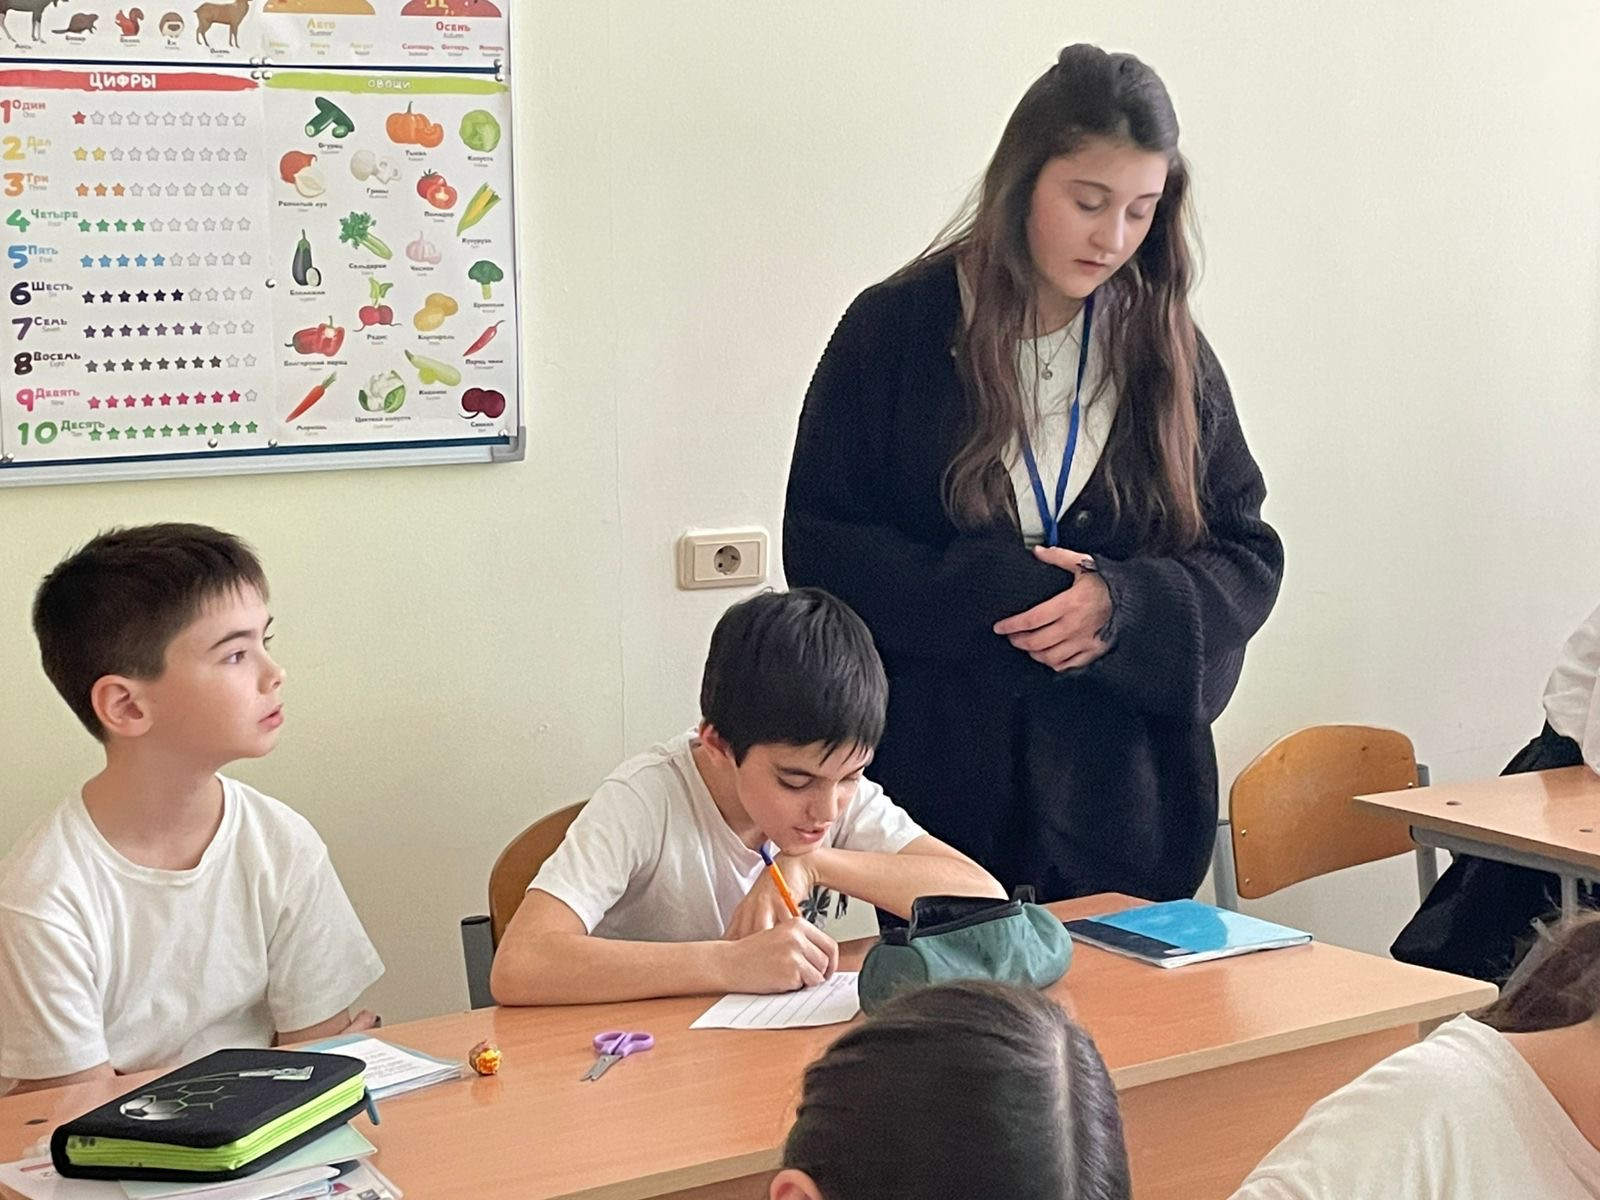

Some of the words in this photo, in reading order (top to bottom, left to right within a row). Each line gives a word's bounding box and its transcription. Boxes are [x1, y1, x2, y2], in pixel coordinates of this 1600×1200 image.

[89, 73, 157, 89] ЦИФРЫ
[367, 79, 411, 89] ОВОЩИ
[0, 99, 11, 124] 1
[12, 99, 46, 111] Один
[2, 135, 26, 161] 2
[3, 172, 24, 197] 3
[26, 172, 49, 185] Три
[6, 208, 31, 233] 4
[30, 208, 79, 221] Четыре
[8, 245, 29, 269] 5
[28, 244, 58, 255] Пять
[10, 281, 32, 306] 6
[31, 281, 73, 291] Шесть
[11, 316, 33, 341] 7
[34, 316, 68, 326] Семь
[14, 352, 33, 376] 8
[33, 351, 81, 361] Восемь
[16, 388, 34, 412] 9
[35, 387, 80, 399] Девять
[17, 421, 58, 446] 10
[60, 420, 105, 431] Десять
